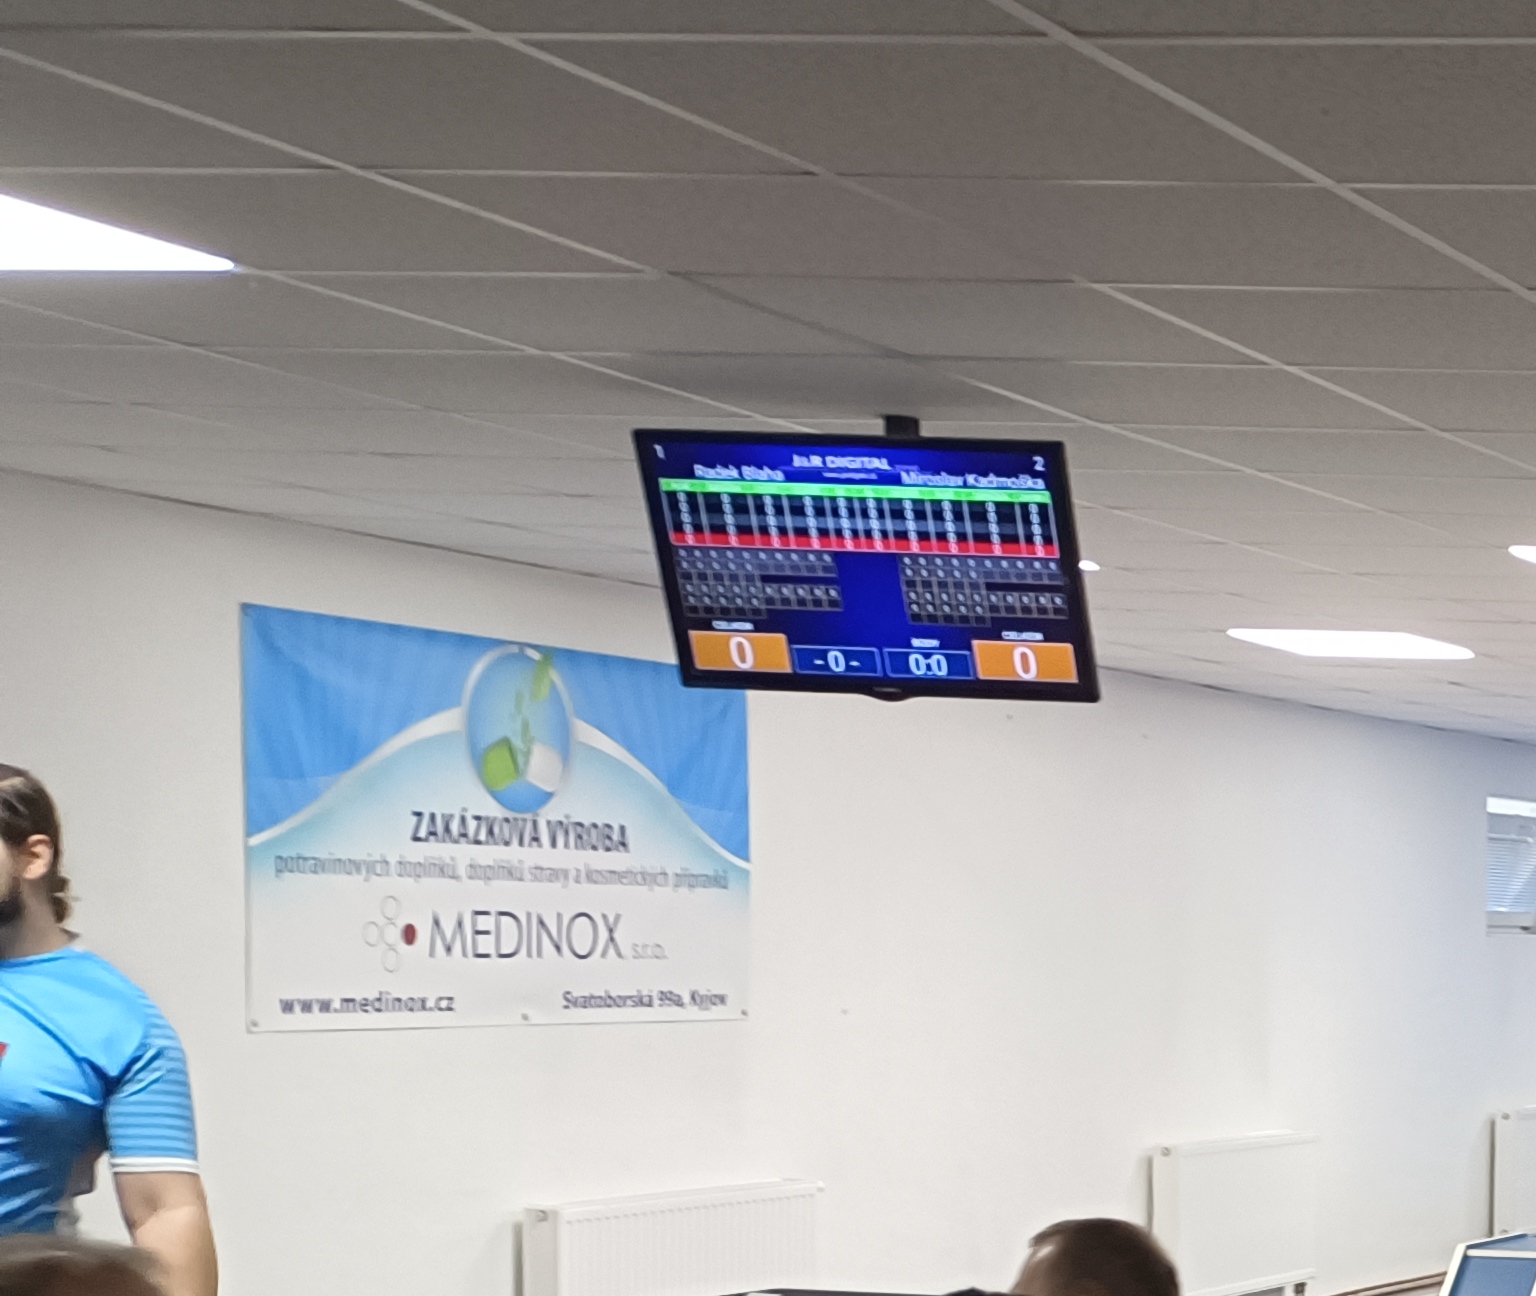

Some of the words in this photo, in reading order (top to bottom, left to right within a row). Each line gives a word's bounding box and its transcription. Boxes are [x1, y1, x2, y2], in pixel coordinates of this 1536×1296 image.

[825, 455, 892, 470] DIGITAL
[1032, 456, 1046, 471] 2
[729, 636, 754, 669] 0
[1013, 646, 1037, 680] 0
[410, 807, 543, 849] ZAKÁZKOVÁ
[546, 814, 630, 853] VÝROBA
[429, 909, 624, 960] MEDINOX
[279, 991, 455, 1014] www.medinox.cz
